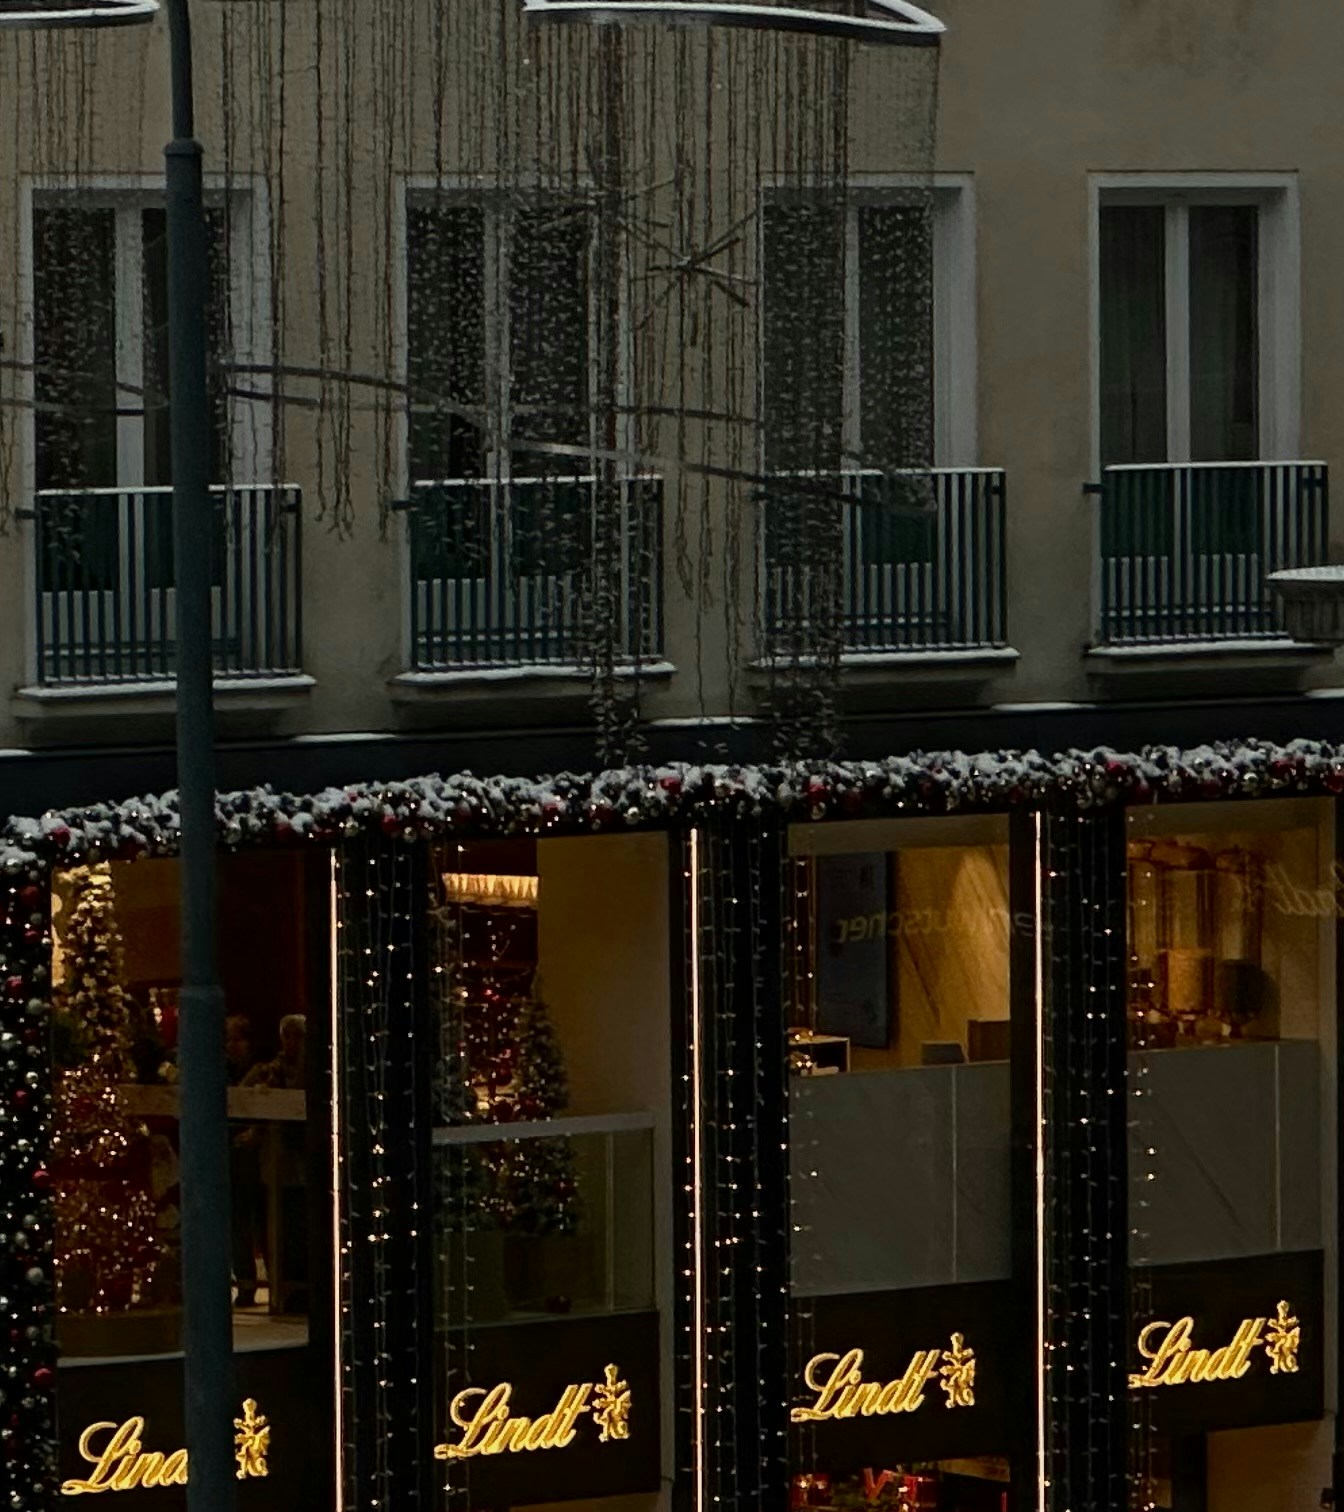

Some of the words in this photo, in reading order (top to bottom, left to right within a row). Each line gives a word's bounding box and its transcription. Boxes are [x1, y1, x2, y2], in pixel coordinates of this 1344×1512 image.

[790, 1347, 942, 1423] Lindt
[1127, 1315, 1268, 1389] Lindt
[432, 1381, 593, 1460] Lindt
